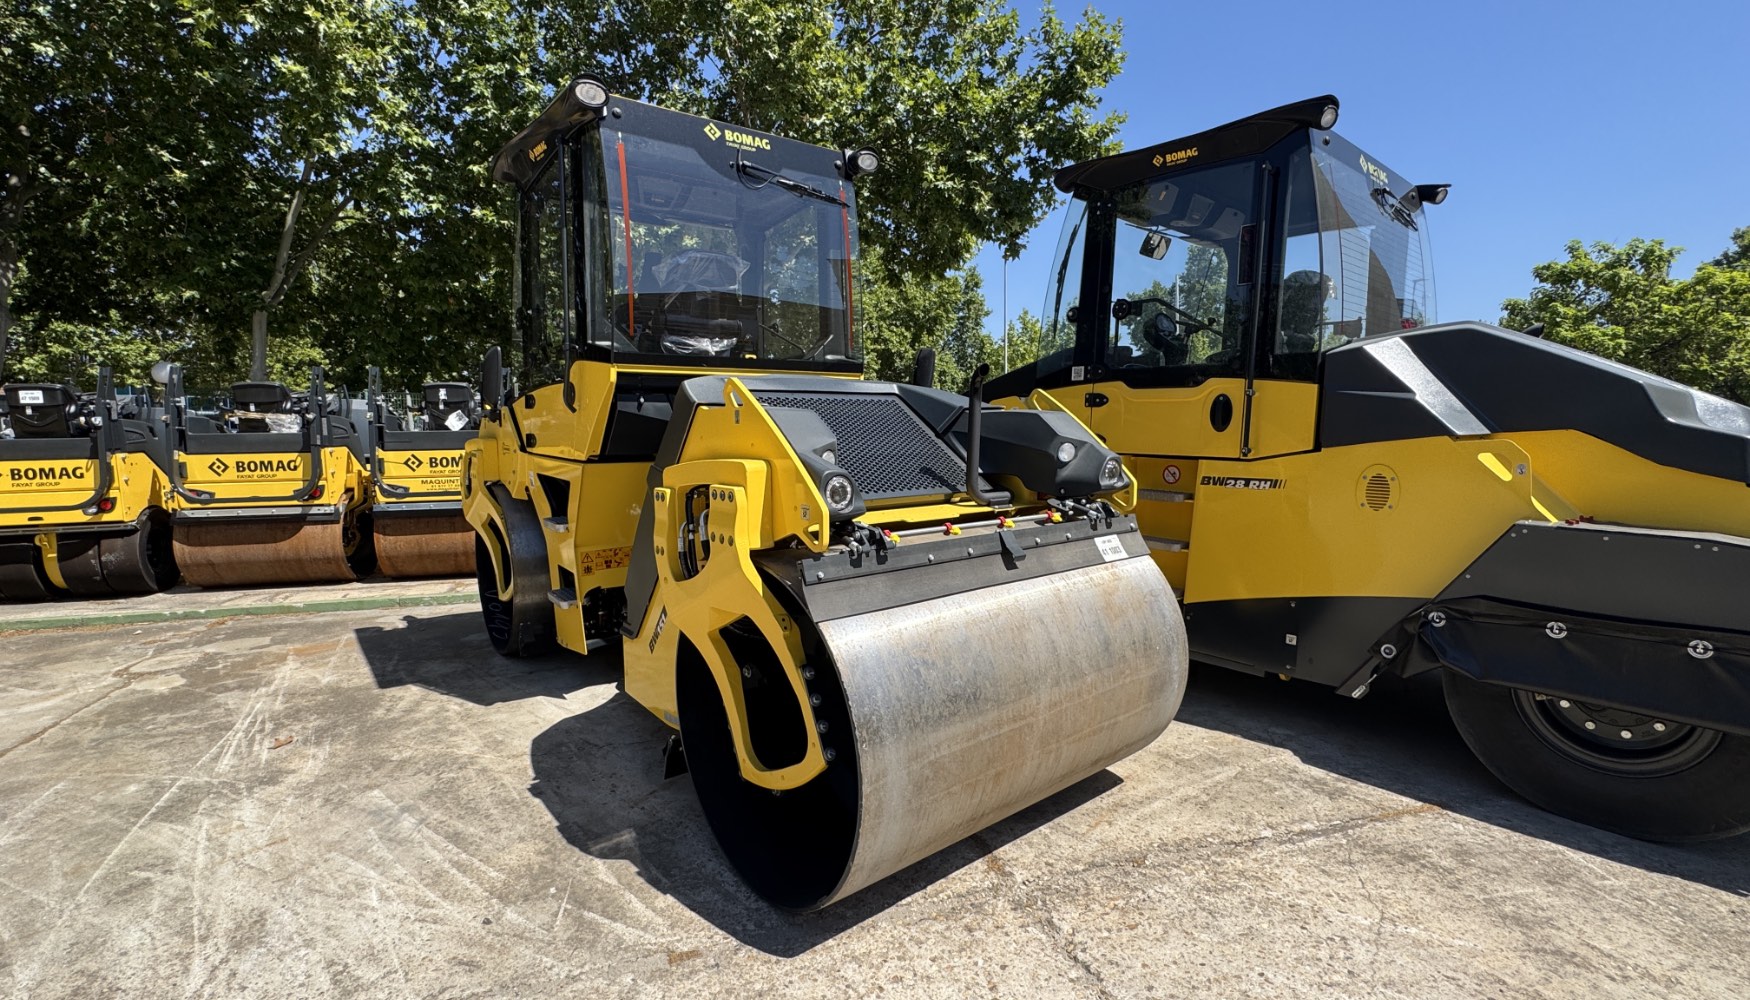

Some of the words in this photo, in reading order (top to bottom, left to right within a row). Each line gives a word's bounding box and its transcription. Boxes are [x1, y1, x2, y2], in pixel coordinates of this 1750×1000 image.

[724, 129, 771, 150] BOMAG
[1165, 147, 1199, 163] BOMAG
[10, 466, 85, 481] BOMAG
[235, 459, 298, 473] BOMAG
